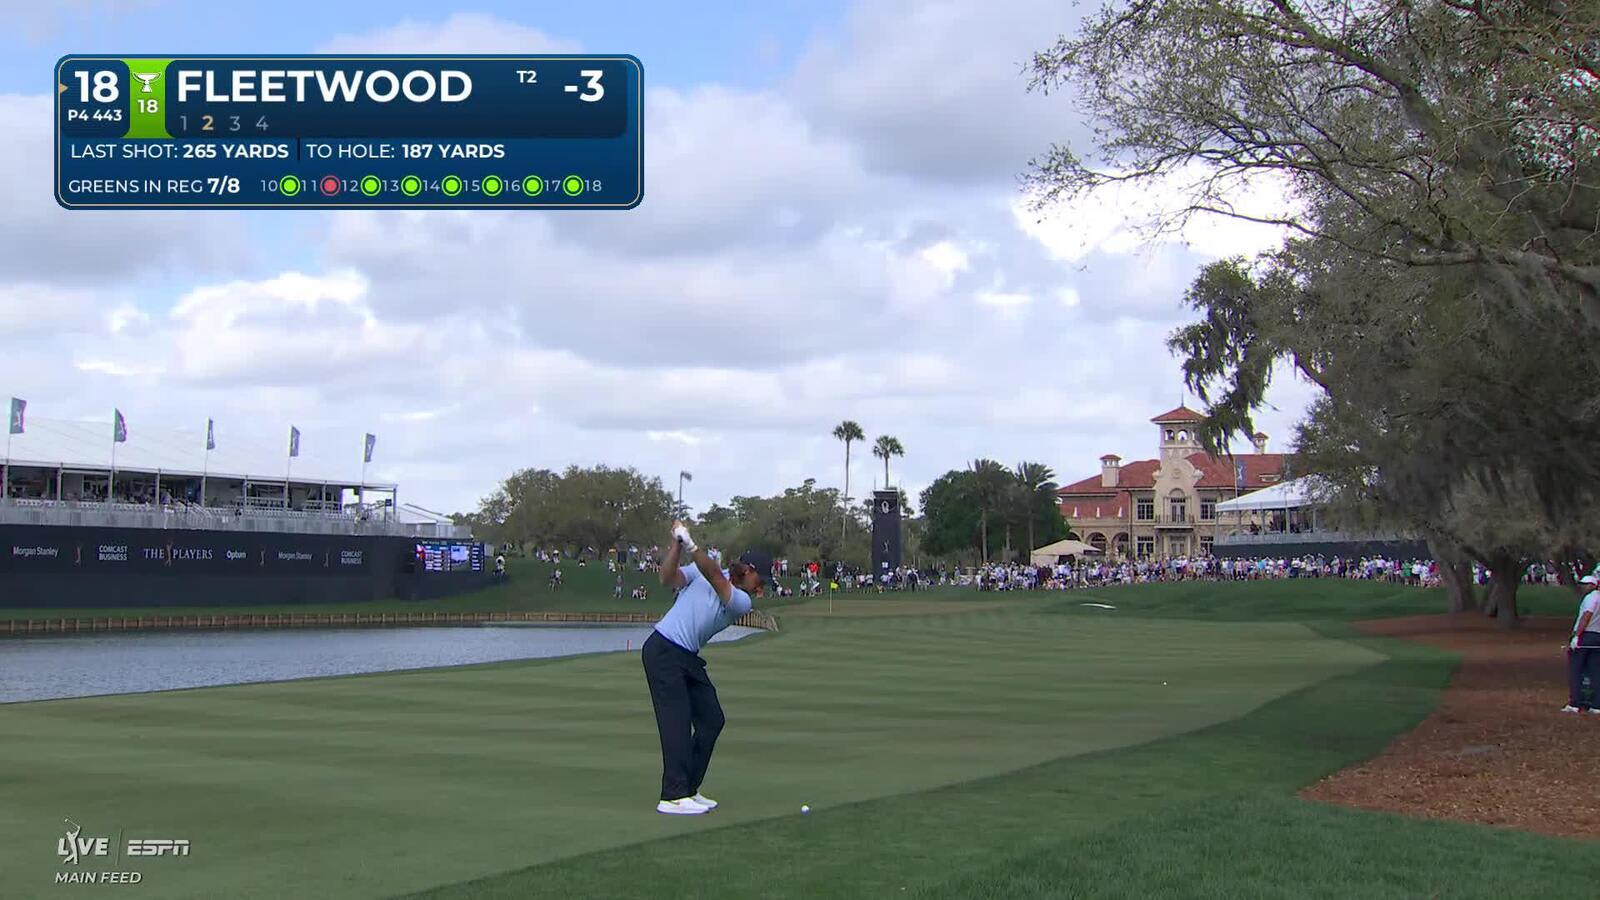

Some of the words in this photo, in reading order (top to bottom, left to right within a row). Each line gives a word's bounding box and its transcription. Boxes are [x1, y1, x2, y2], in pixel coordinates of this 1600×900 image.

[13, 546, 36, 557] Morgan
[37, 546, 59, 557] Stanley
[99, 545, 128, 553] COMCAST
[144, 548, 164, 559] THE
[172, 548, 213, 560] PLAYERS
[99, 553, 128, 561] BUSINESS
[226, 550, 247, 560] Optum
